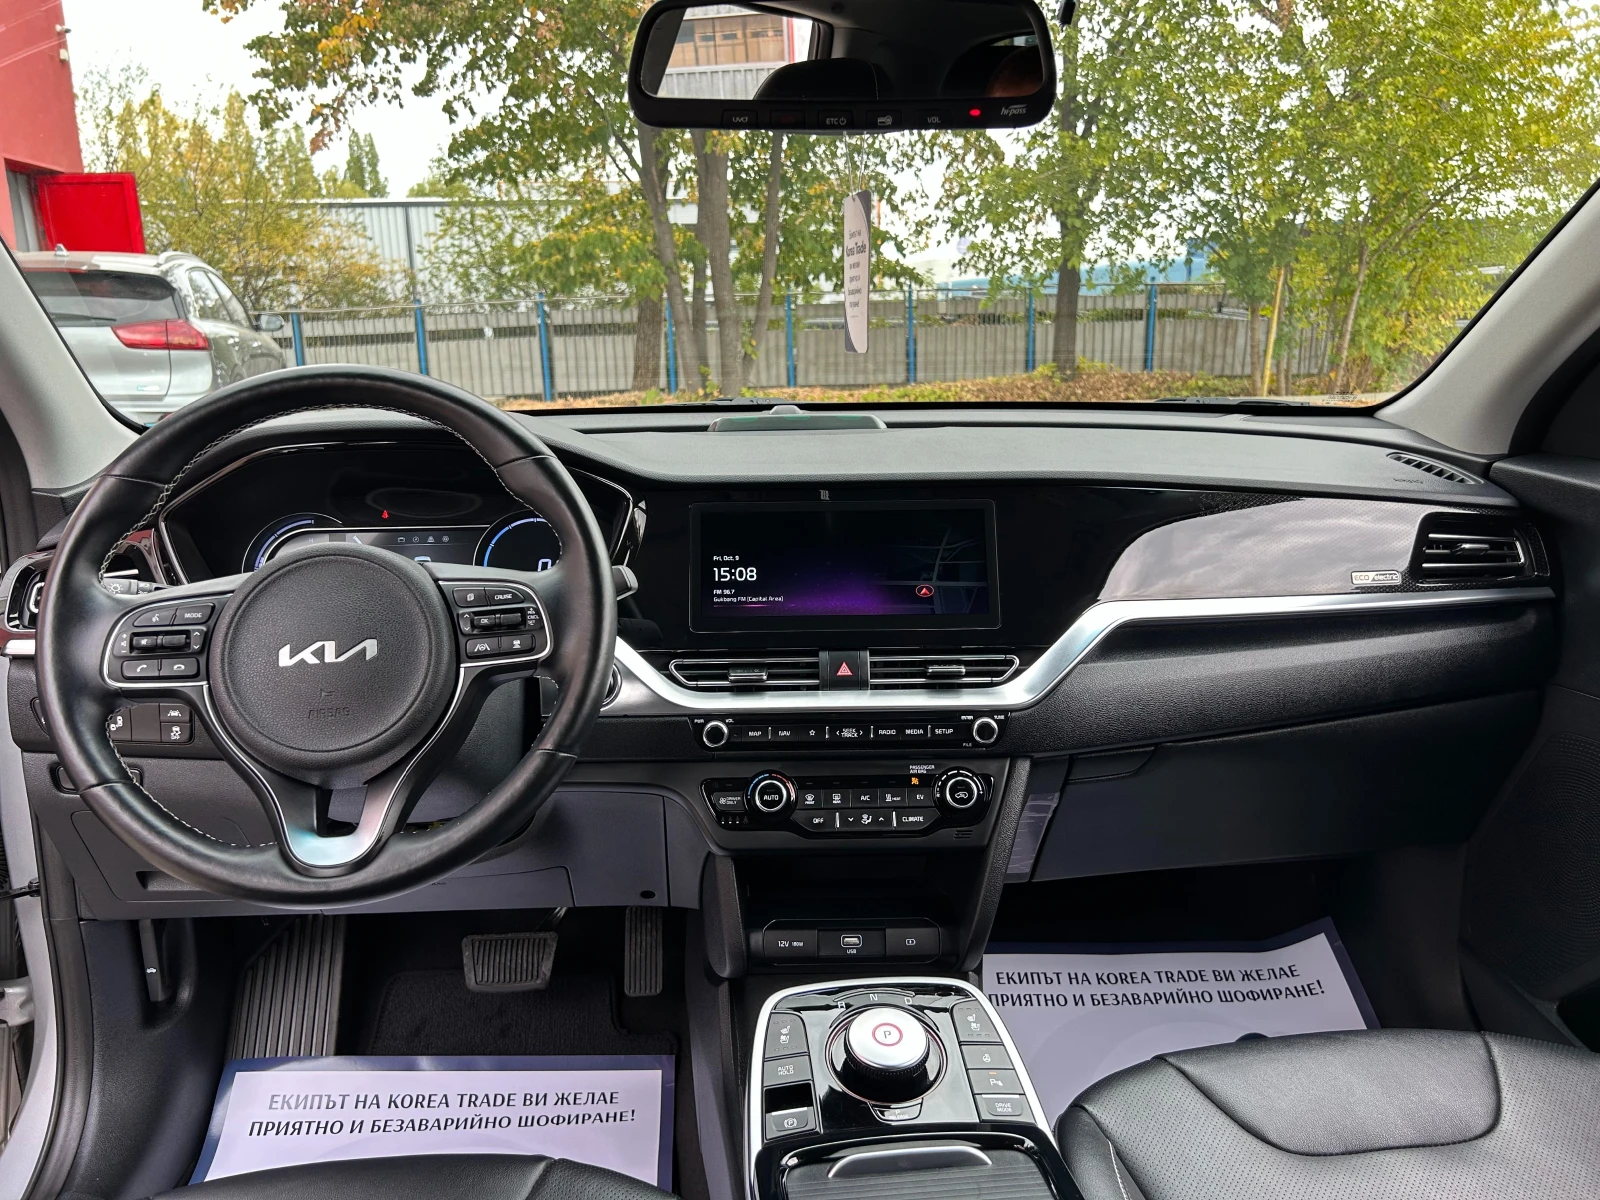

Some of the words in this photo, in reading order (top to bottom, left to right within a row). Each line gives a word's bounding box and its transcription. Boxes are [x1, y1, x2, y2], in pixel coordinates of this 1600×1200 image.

[826, 117, 839, 125] ETC
[713, 567, 757, 581] 15:08
[1374, 573, 1399, 581] electric
[279, 639, 377, 667] KIA
[996, 972, 1062, 985] ЕКИПЪТ
[1068, 972, 1092, 985] НА
[1096, 971, 1152, 985] KOREA
[1154, 970, 1209, 984] TRADE
[1212, 969, 1236, 982] ВИ
[1238, 964, 1300, 981] ЖЕЛАЕ
[869, 993, 878, 1001] N
[988, 993, 1068, 1007] ПРИЯТНО
[1073, 993, 1085, 1007] И
[1090, 988, 1213, 1006] БЕЗАВАРИЙНО
[1217, 979, 1325, 1003] ШОФИРАНЕ!
[837, 1001, 846, 1009] R
[904, 997, 913, 1005] D
[883, 1031, 892, 1039] P
[268, 1093, 350, 1110] ЕКИПЪТ
[354, 1093, 381, 1110] НА
[388, 1093, 450, 1109] KOREA
[457, 1093, 517, 1108] TRADE
[522, 1092, 548, 1107] ВИ
[553, 1091, 619, 1106] ЖЕЛАЕ
[248, 1120, 344, 1137] ПРИЯТНО
[349, 1119, 364, 1134] И
[370, 1113, 512, 1134] БЕЗАВАРИЙНО
[517, 1109, 636, 1128] ШОФИРАНЕ!
